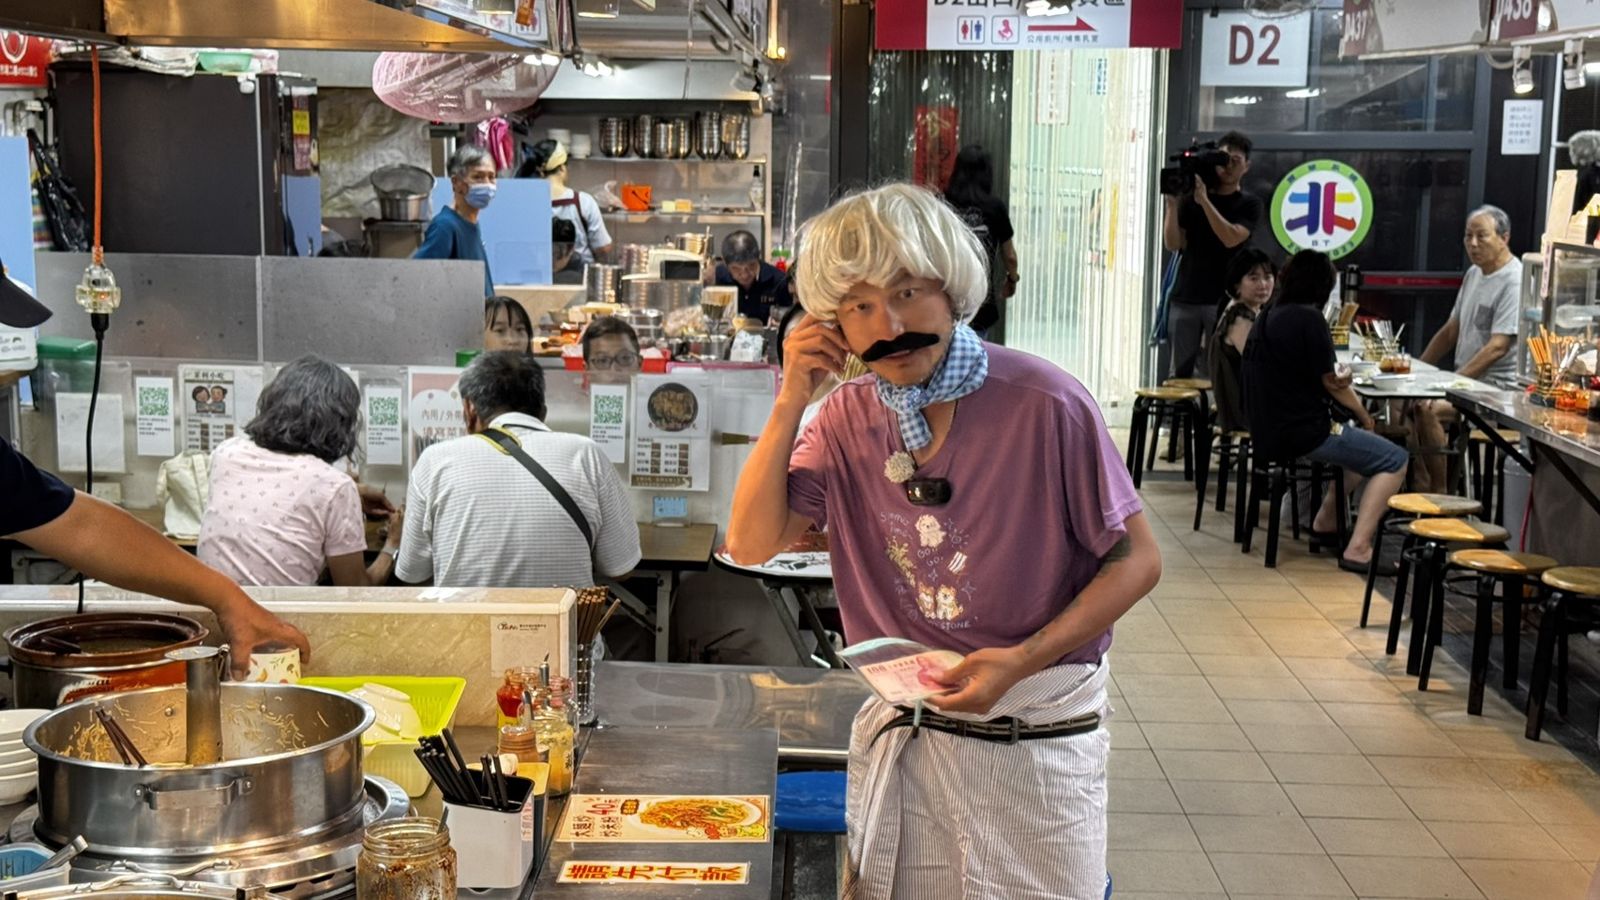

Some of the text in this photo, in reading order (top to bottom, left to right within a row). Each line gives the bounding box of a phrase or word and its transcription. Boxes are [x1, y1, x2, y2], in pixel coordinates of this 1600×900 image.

[1228, 24, 1281, 66] D2
[567, 864, 743, 881] 請先付款
